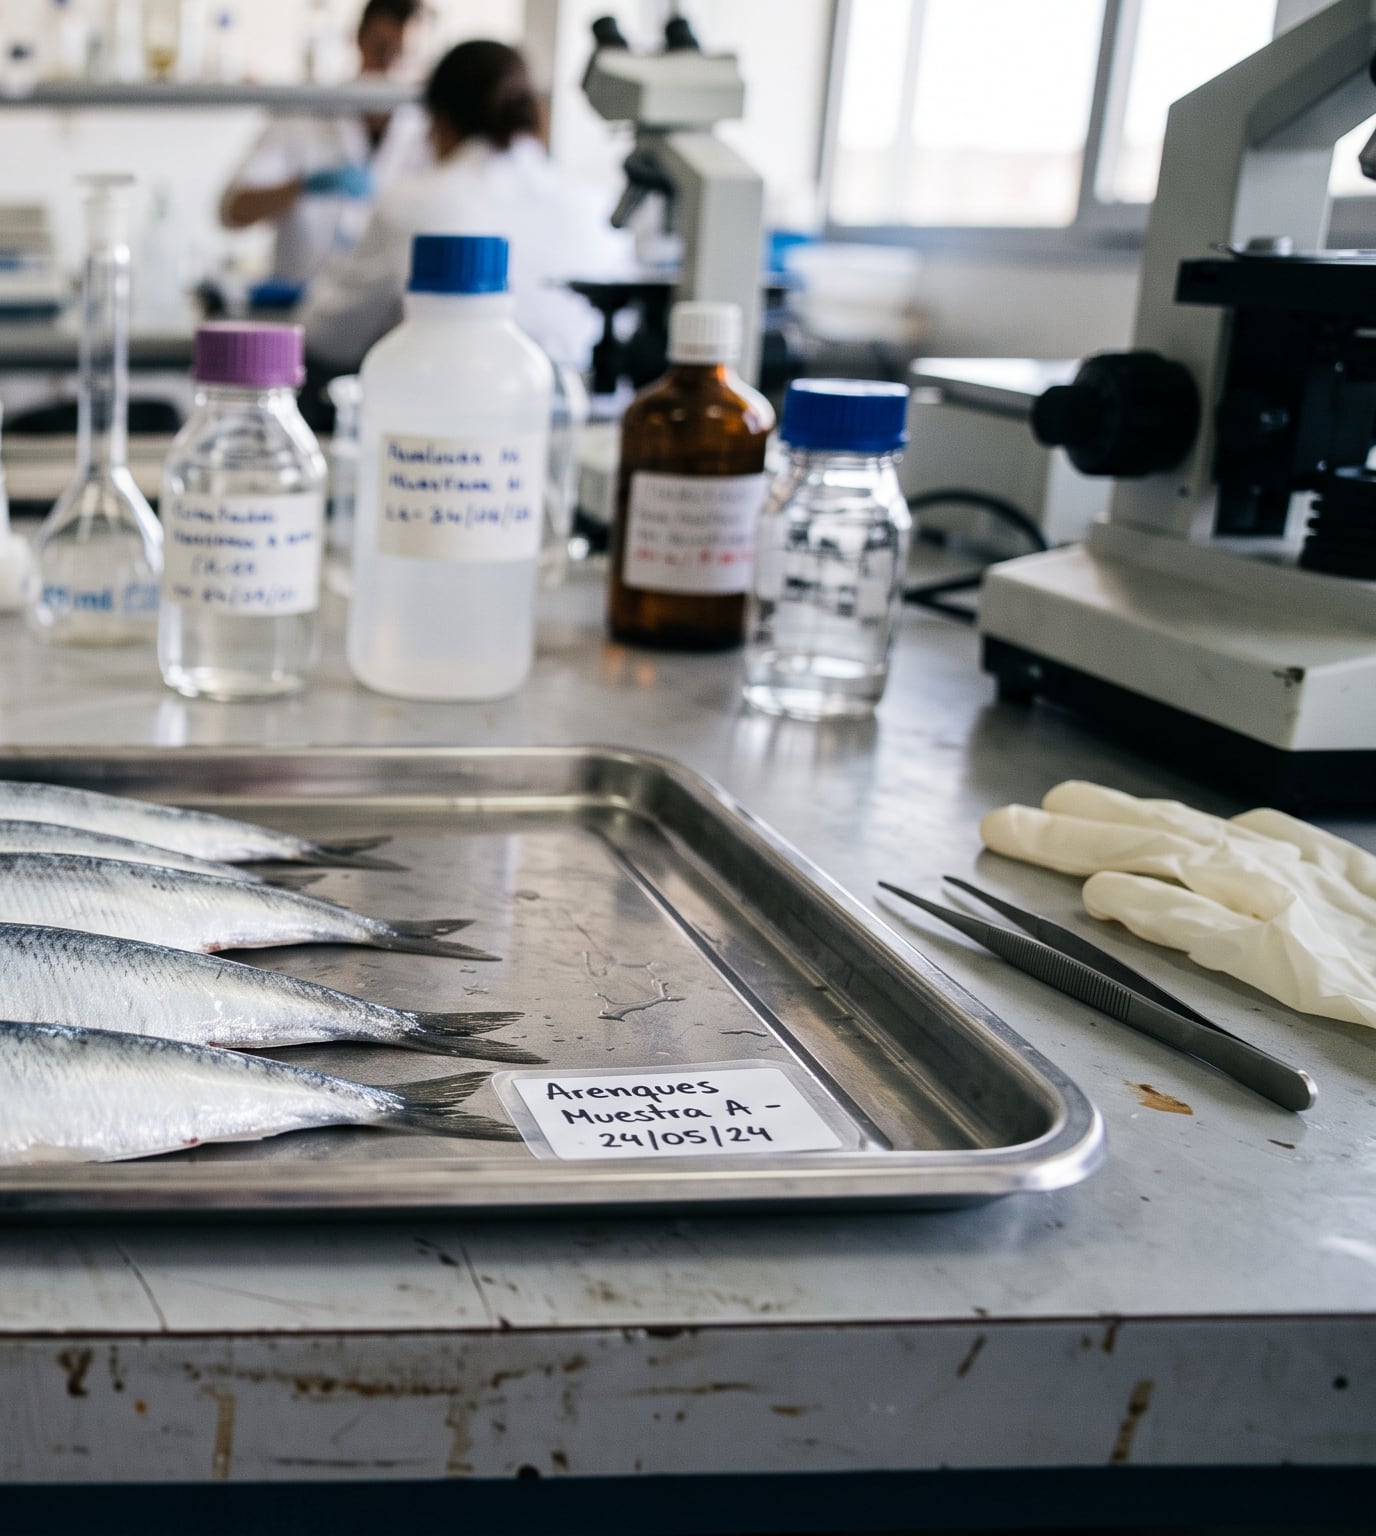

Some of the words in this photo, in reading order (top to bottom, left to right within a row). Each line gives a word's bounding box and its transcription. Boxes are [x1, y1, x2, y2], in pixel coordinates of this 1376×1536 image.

[546, 1080, 720, 1103] Arenques
[560, 1103, 712, 1125] Muestra
[725, 1099, 752, 1116] A
[598, 1125, 773, 1151] 24/05/24
